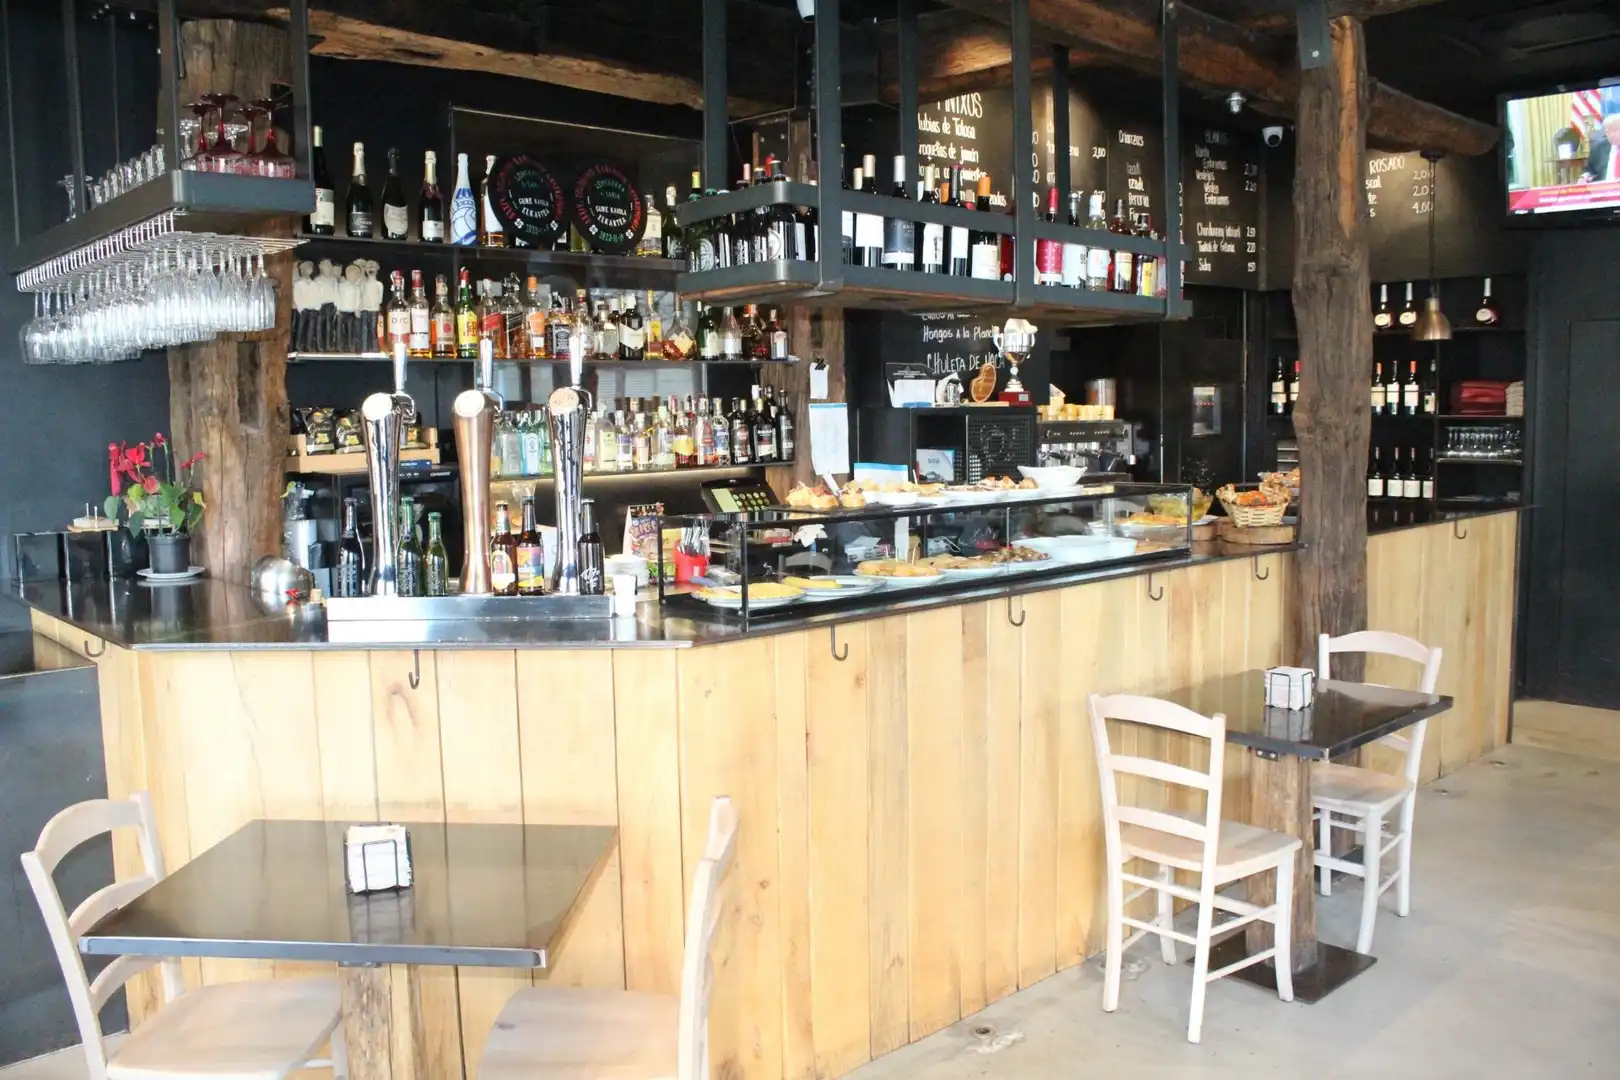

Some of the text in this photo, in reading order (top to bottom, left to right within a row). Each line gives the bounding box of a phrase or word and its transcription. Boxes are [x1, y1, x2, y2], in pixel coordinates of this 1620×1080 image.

[918, 113, 976, 139] lubias de Tolosa
[919, 141, 947, 160] roquetas
[948, 142, 956, 159] de
[1369, 156, 1405, 174] ROSADO
[1365, 175, 1382, 189] scal
[922, 325, 953, 343] Hongos
[963, 326, 970, 338] la
[973, 325, 996, 341] Planch
[927, 352, 966, 374] CHULETA
[969, 354, 980, 371] DE
